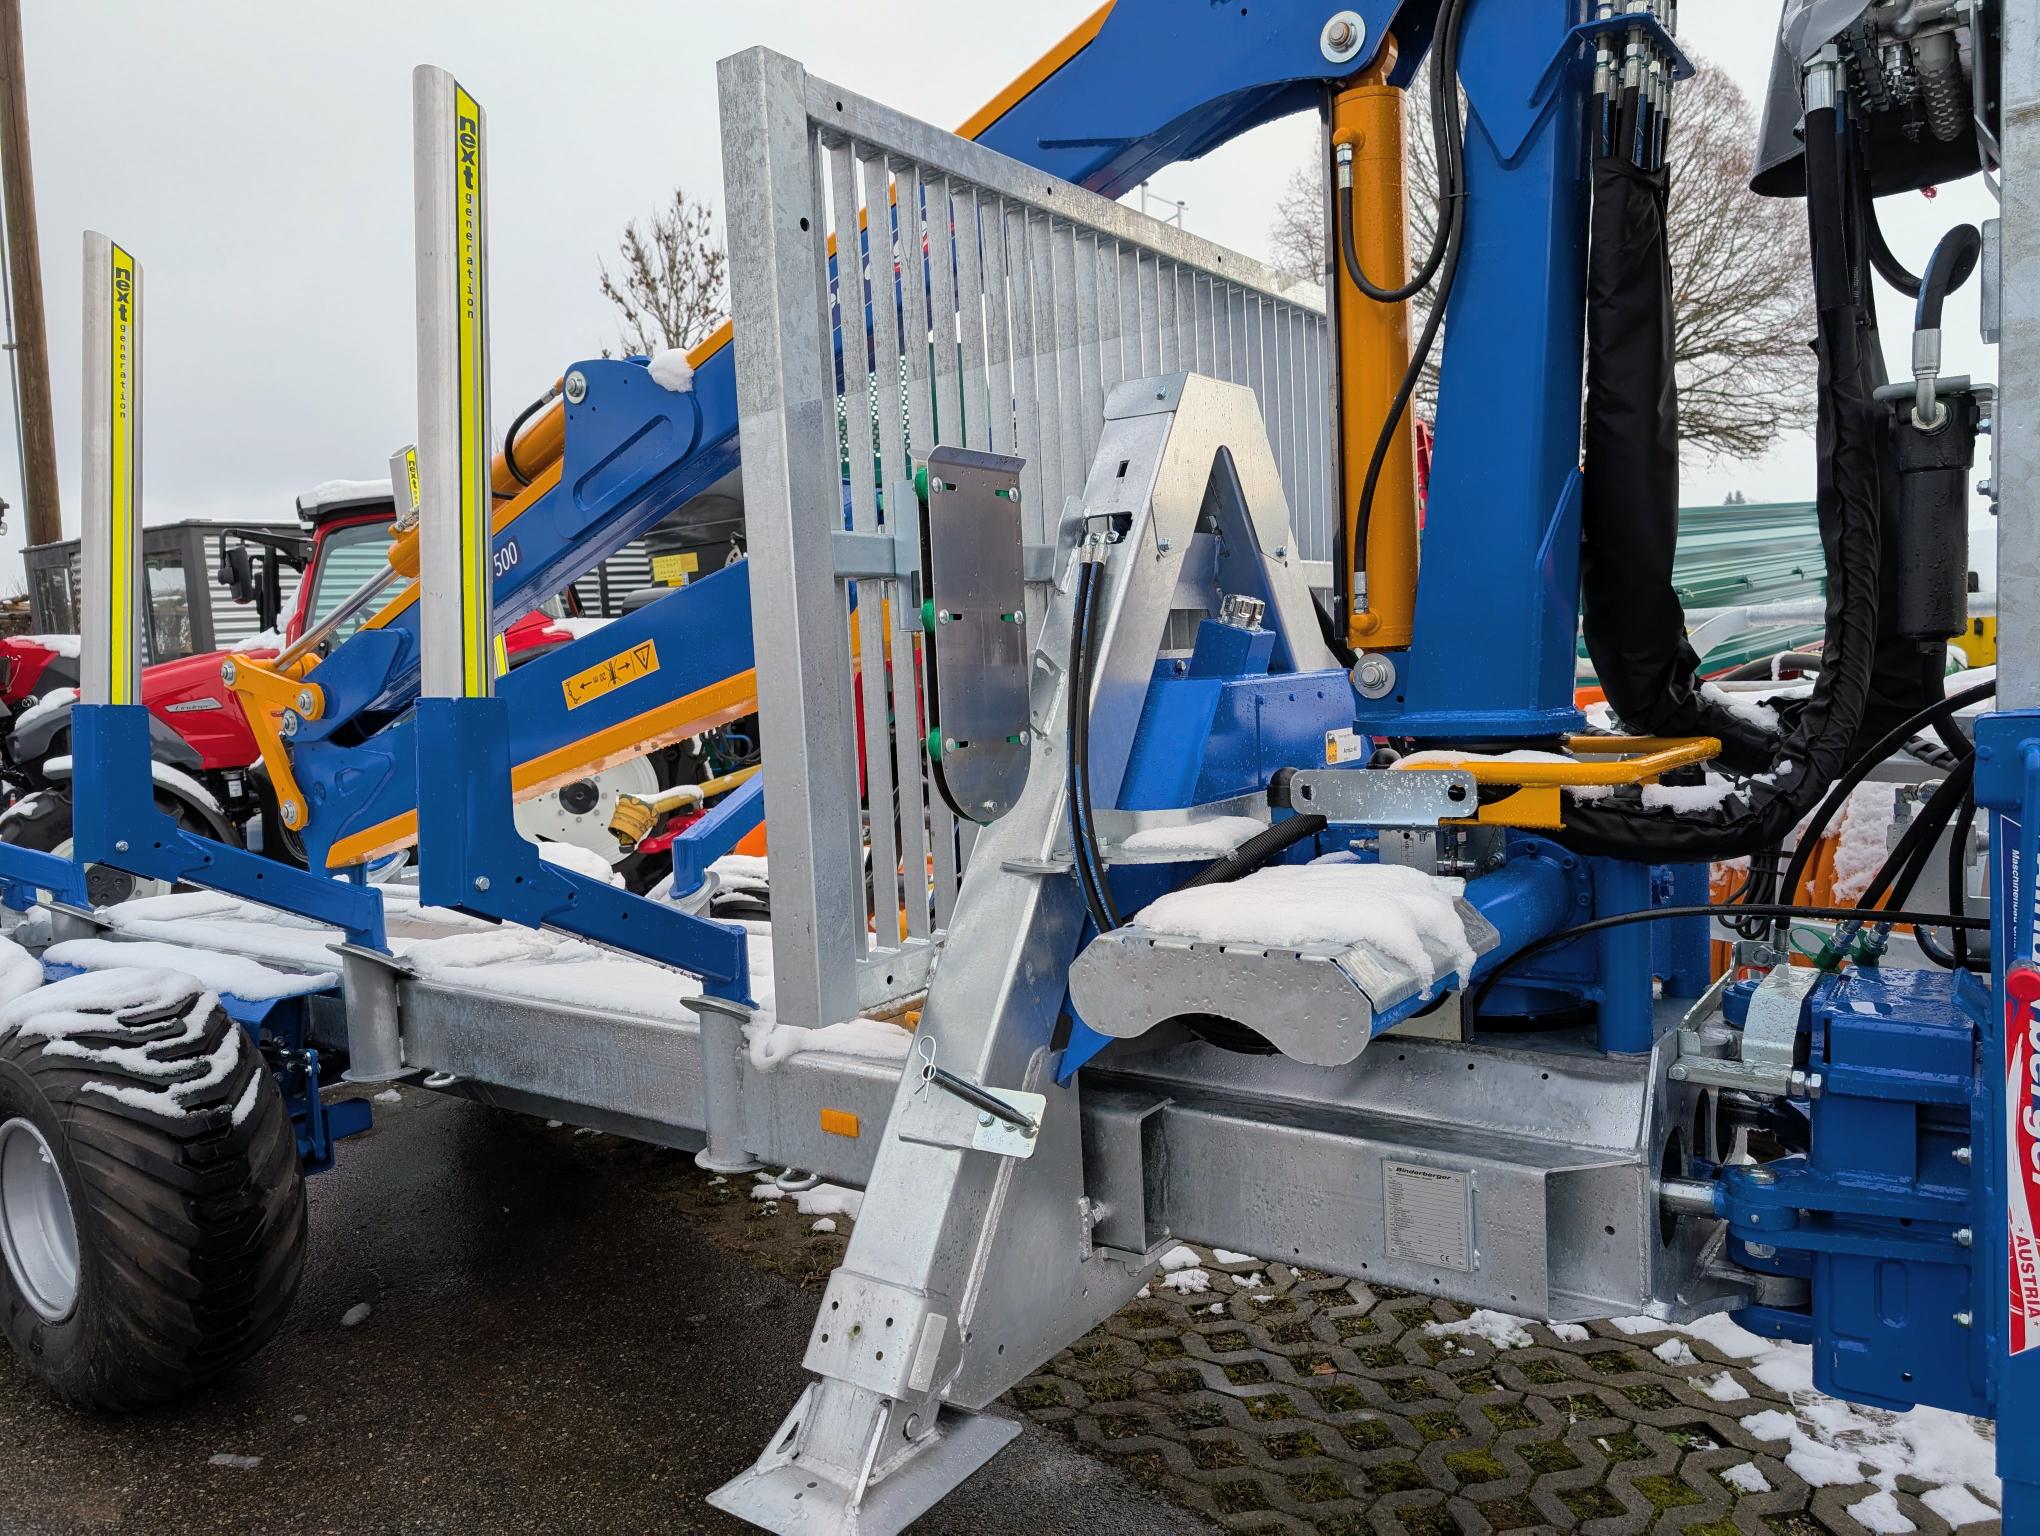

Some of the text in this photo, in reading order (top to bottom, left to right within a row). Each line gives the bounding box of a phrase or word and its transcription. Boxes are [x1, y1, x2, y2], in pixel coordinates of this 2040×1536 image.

[460, 115, 476, 319] next generation
[115, 267, 131, 322] next
[408, 460, 417, 489] next
[493, 541, 518, 577] 500
[1395, 1166, 1452, 1180] Binderberger
[2016, 1235, 2040, 1319] AUSTRIA
